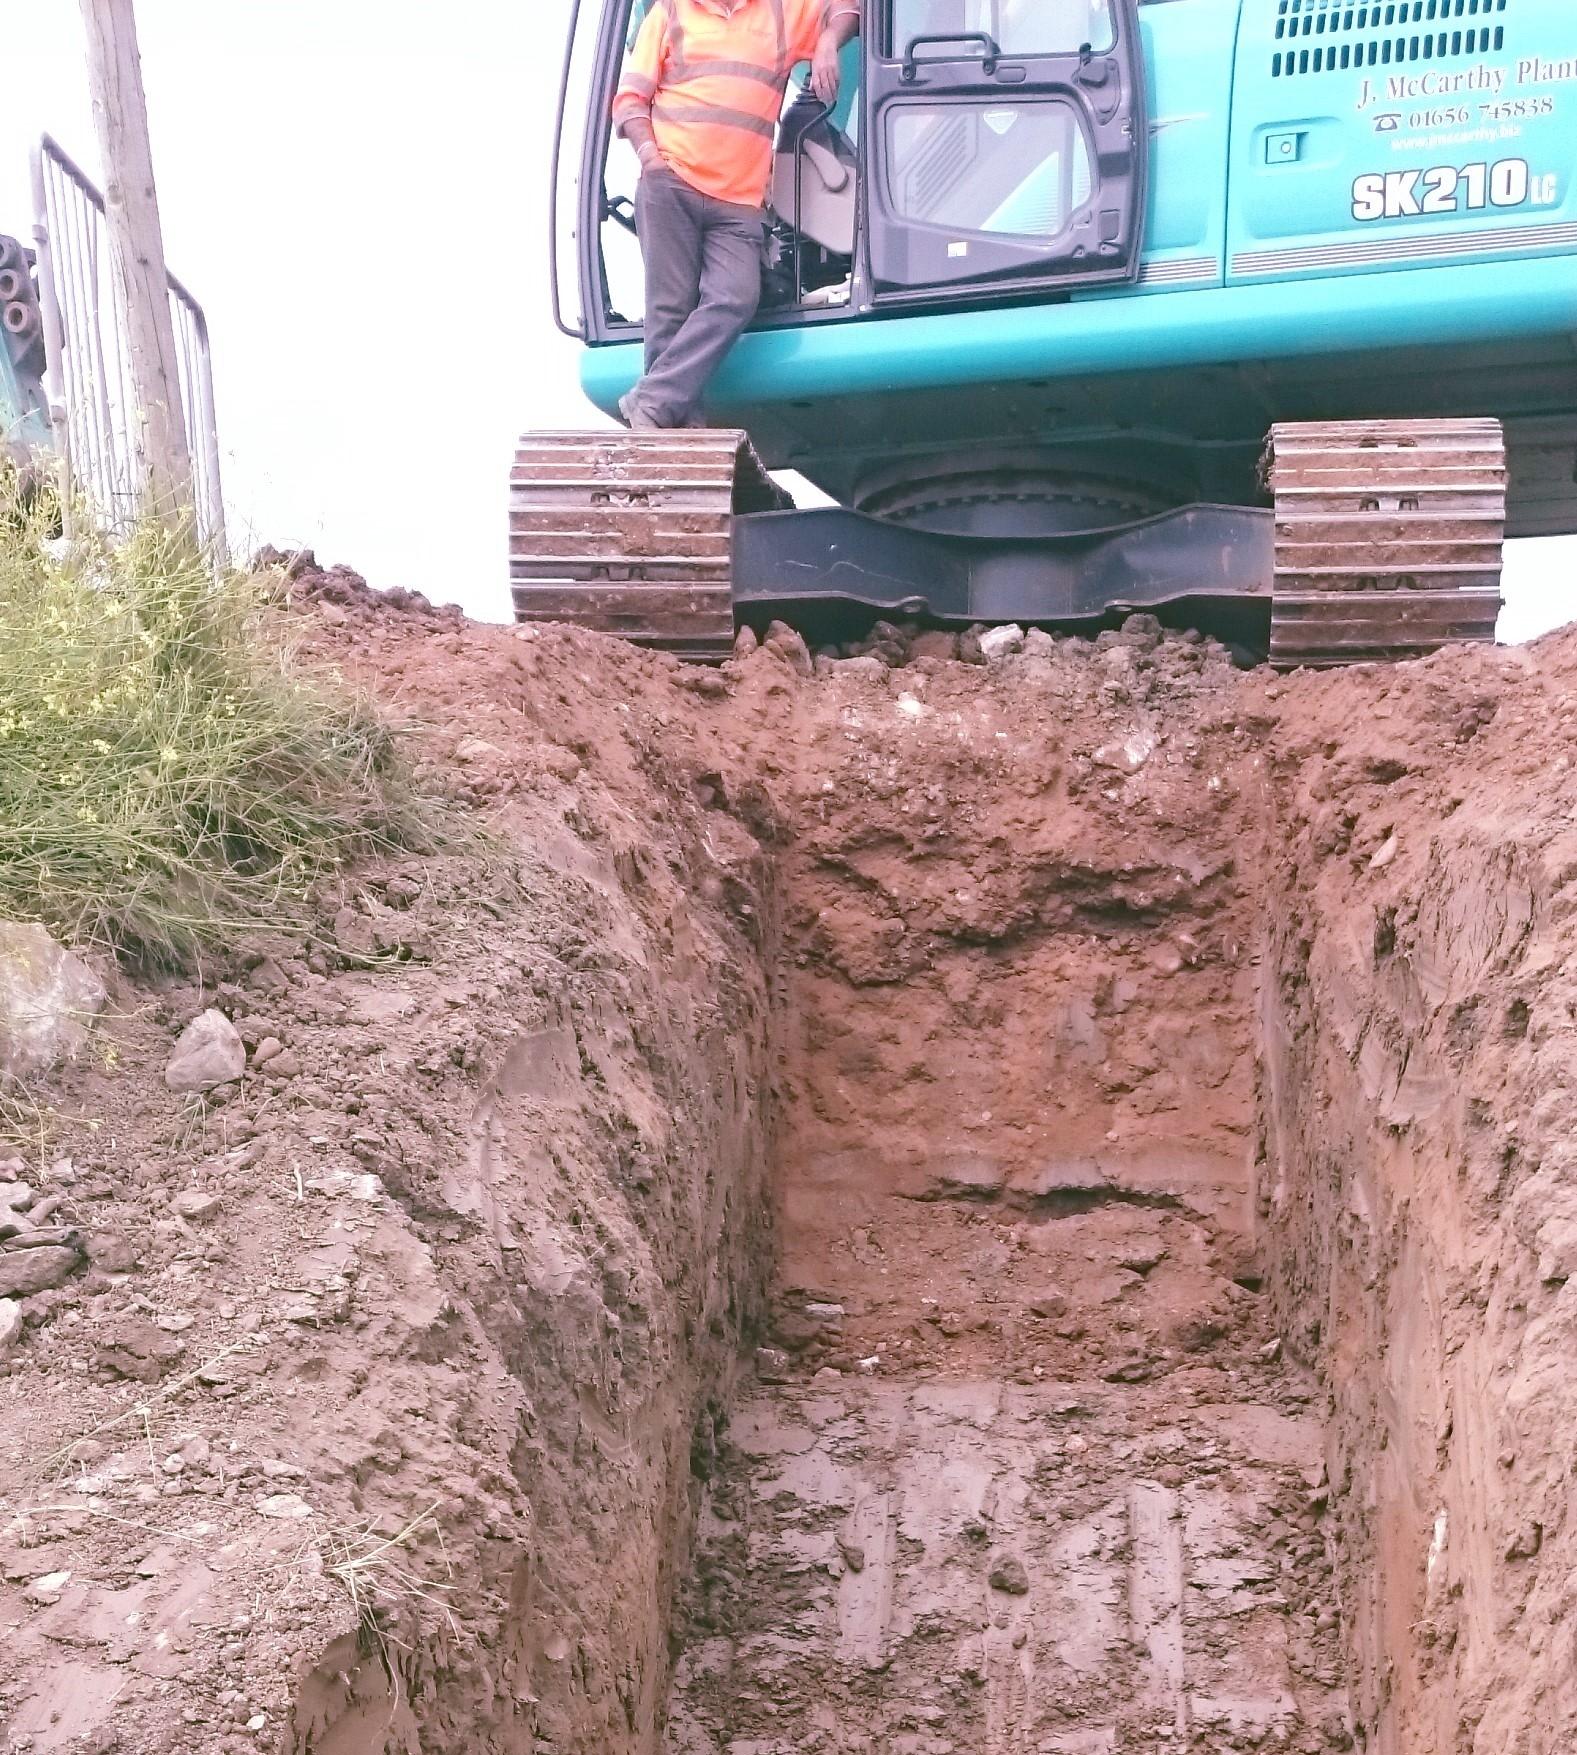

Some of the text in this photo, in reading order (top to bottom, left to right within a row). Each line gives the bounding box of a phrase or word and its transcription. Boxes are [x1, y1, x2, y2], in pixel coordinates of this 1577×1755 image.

[1357, 80, 1377, 109] J.
[1387, 64, 1505, 99] McCarthy
[1409, 97, 1553, 128] 01656 745838
[1351, 158, 1529, 222] SK210
